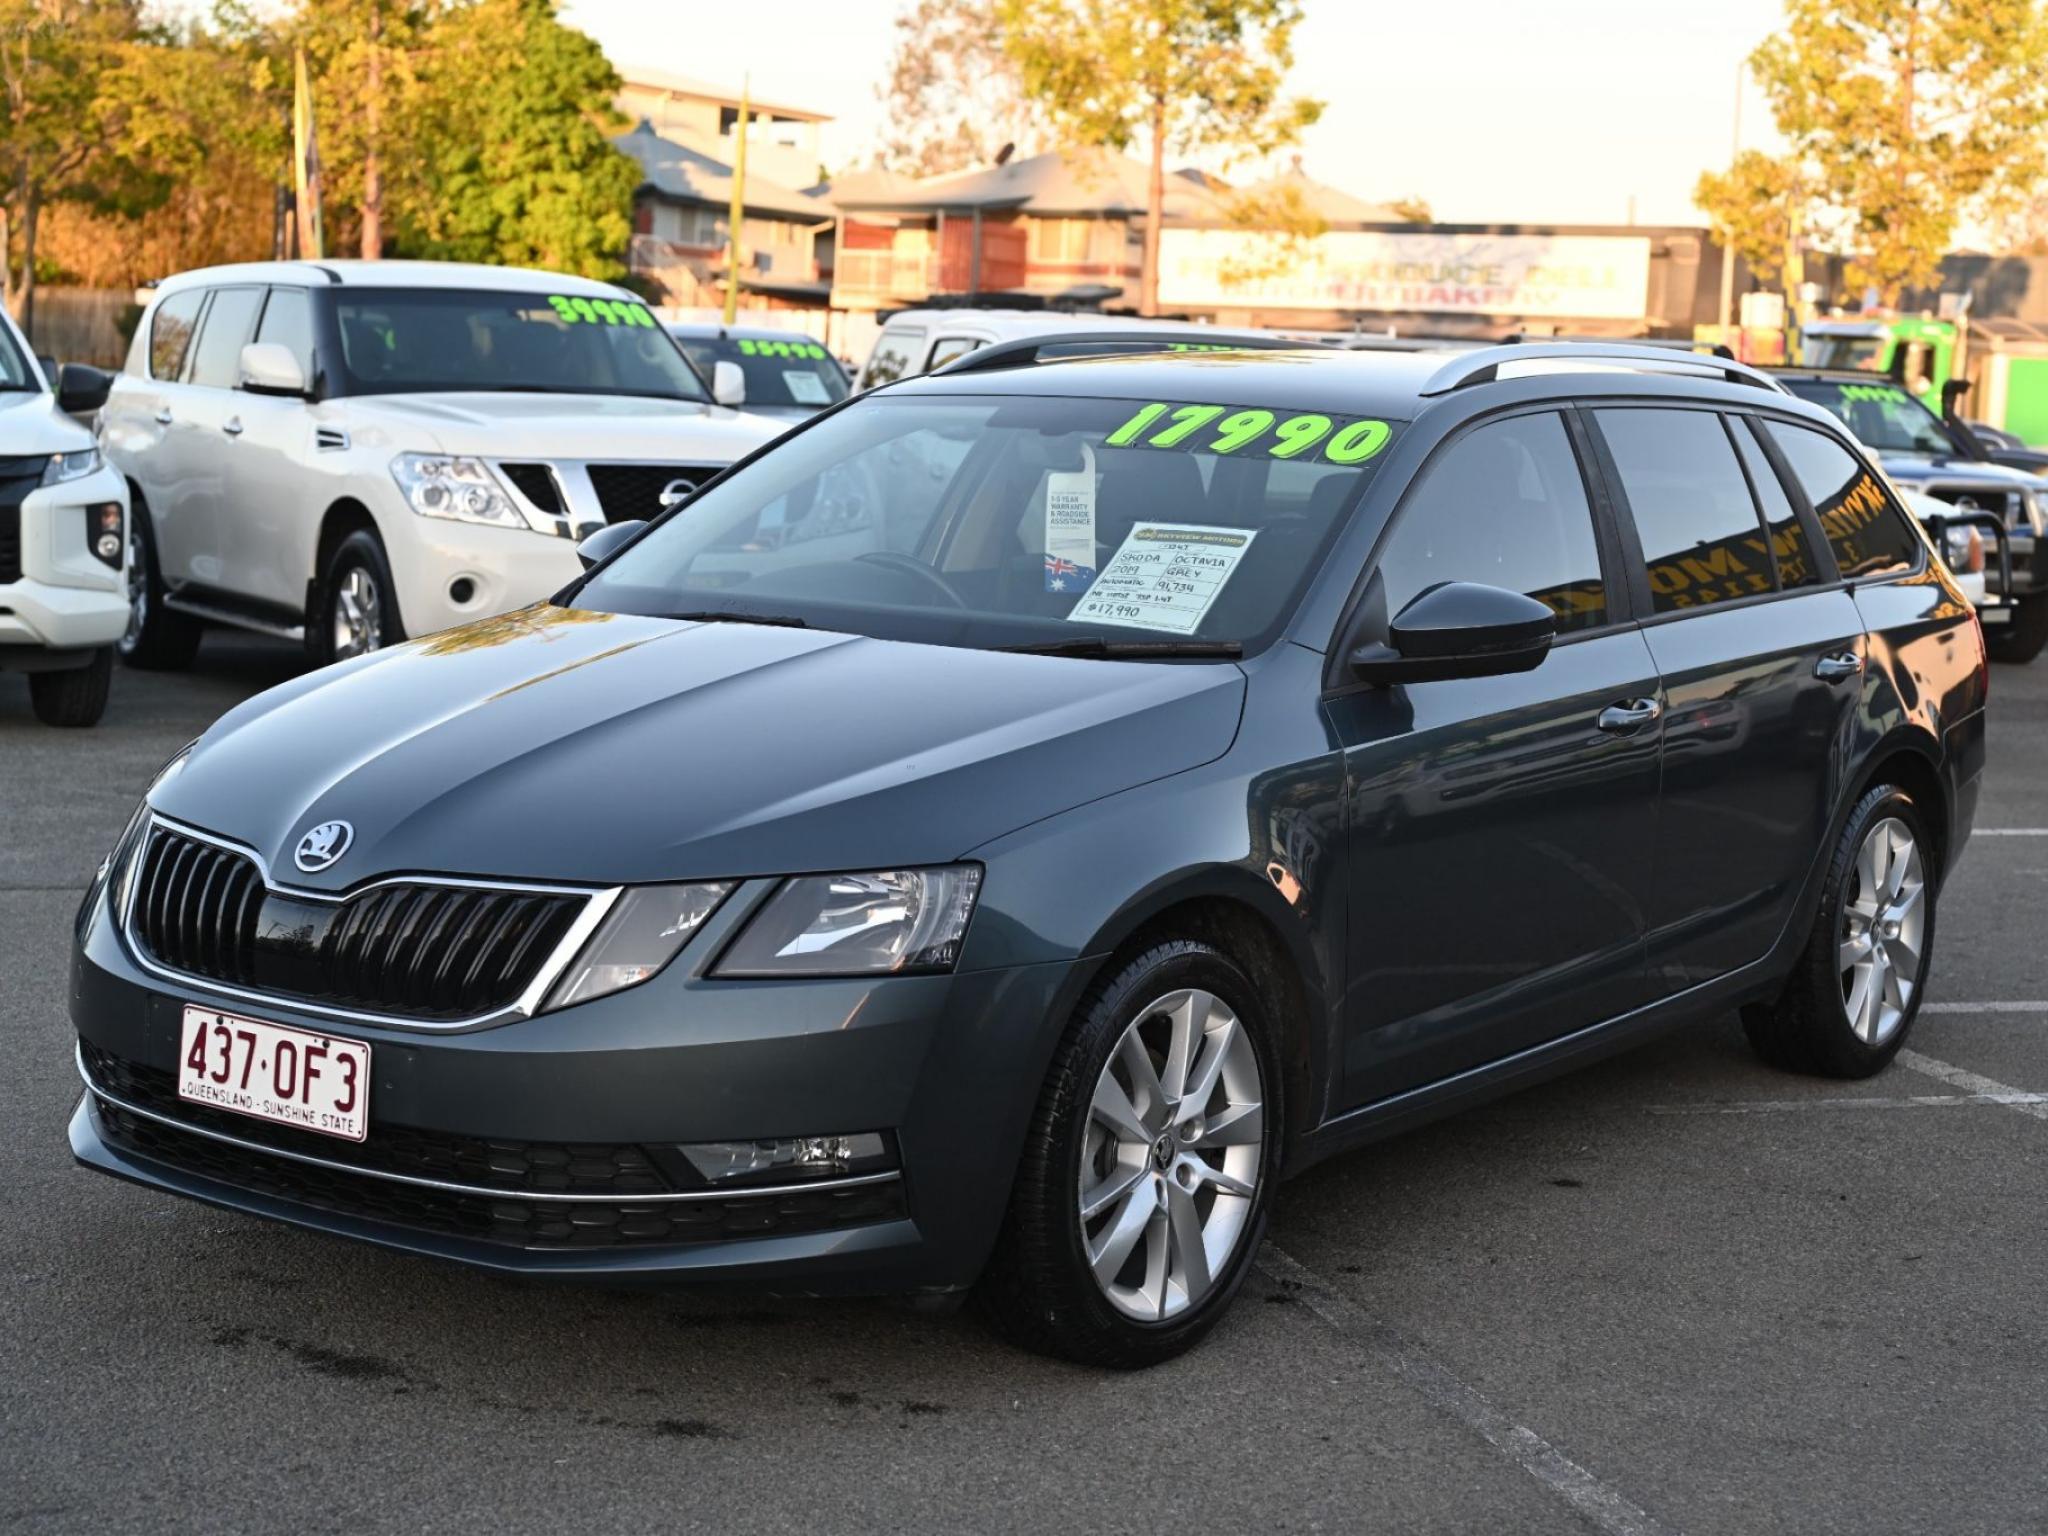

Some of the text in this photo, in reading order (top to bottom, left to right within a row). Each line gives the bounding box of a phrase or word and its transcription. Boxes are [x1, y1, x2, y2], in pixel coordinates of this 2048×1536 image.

[548, 295, 655, 329] 39990
[1105, 403, 1392, 465] 17990
[1062, 495, 1079, 503] YEAR
[1057, 510, 1089, 518] ROADSIDE
[1121, 553, 1161, 563] SKODA
[1174, 555, 1226, 567] OCTAVIA
[1111, 565, 1140, 575] 2019
[1166, 567, 1202, 577] GREY
[1087, 602, 1140, 618] $17,990
[187, 1081, 252, 1109] QUEENSLAND
[263, 1099, 315, 1124] SUNSHINE
[321, 1113, 354, 1133] STATE
